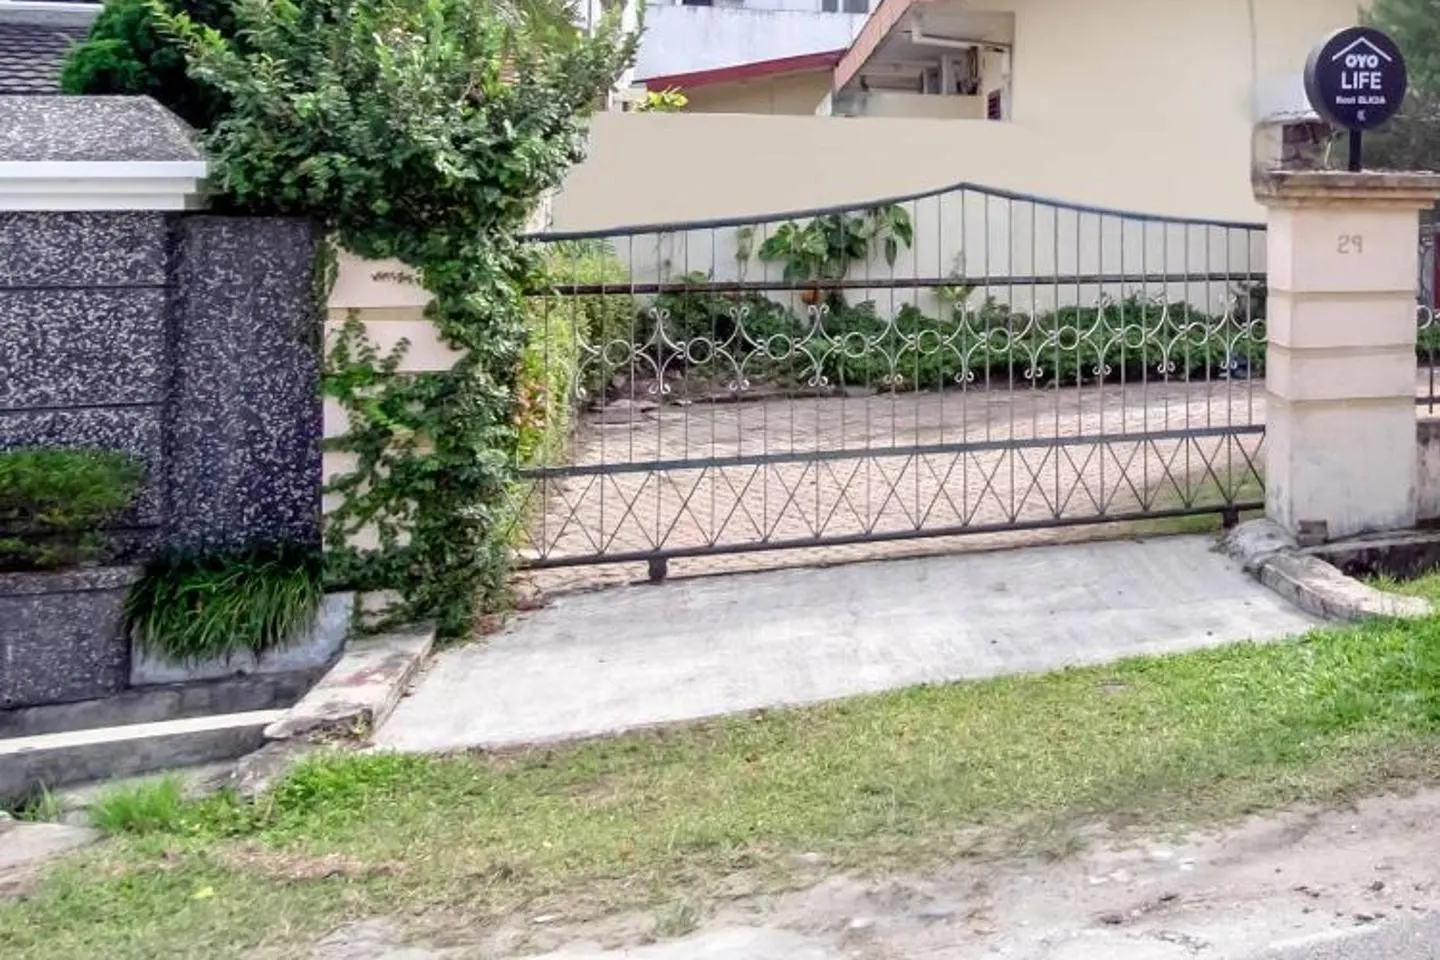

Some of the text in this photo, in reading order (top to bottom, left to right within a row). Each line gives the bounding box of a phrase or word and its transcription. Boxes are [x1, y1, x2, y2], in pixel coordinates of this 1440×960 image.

[1345, 54, 1379, 68] OYO
[1341, 71, 1382, 89] LIFE
[1337, 234, 1363, 254] 29
